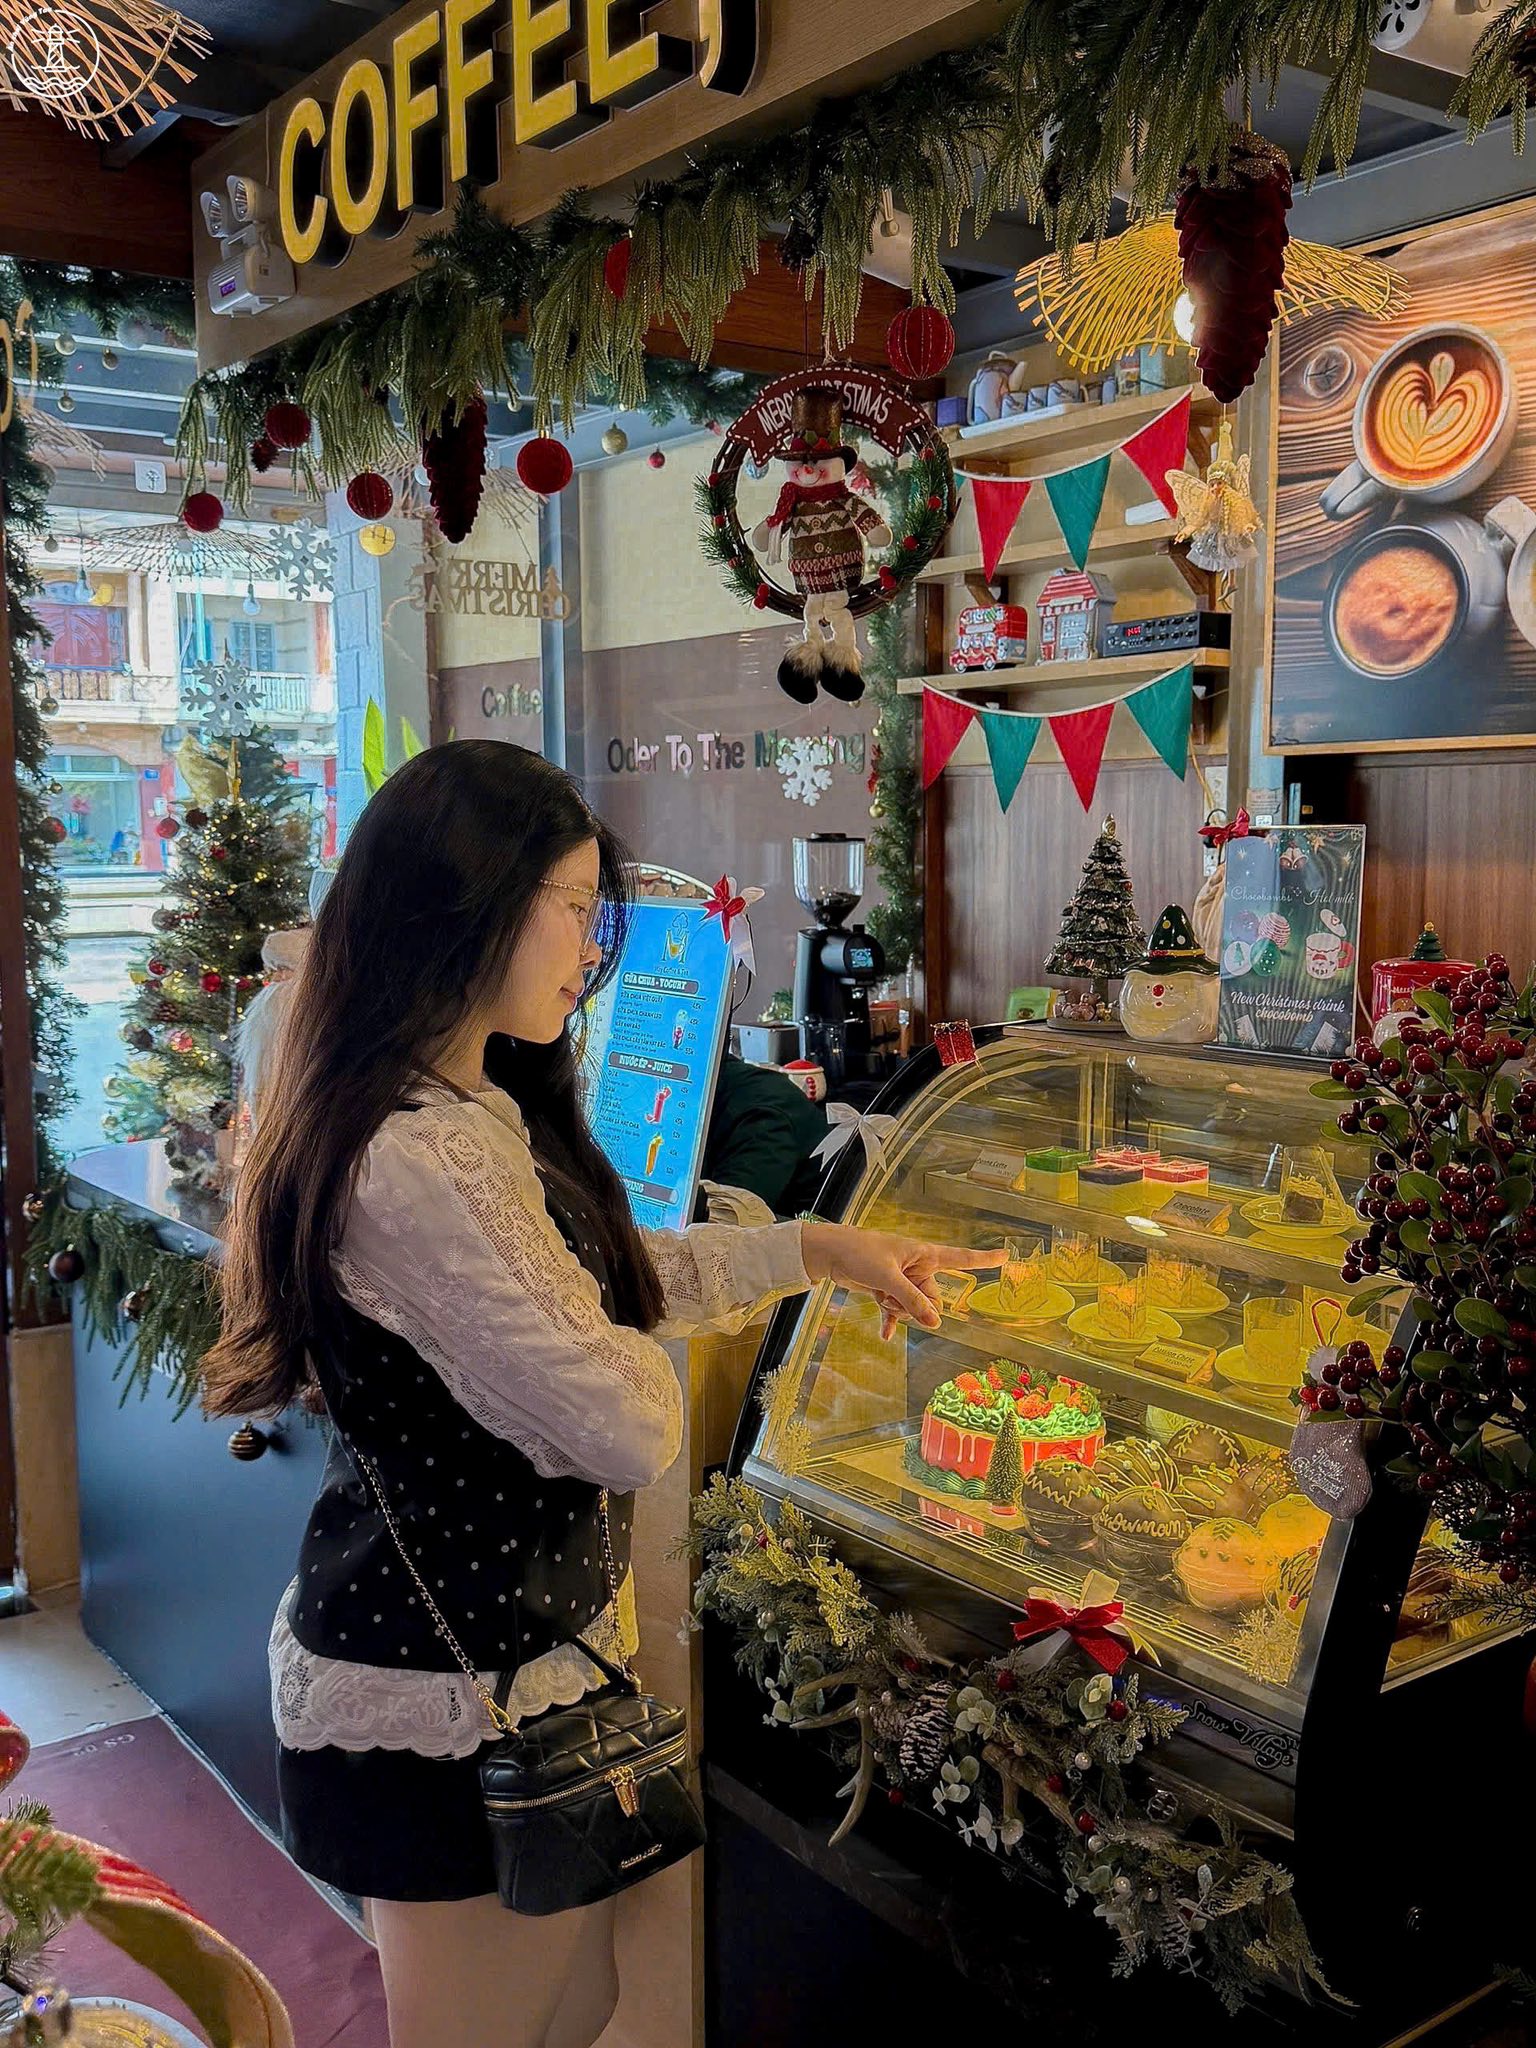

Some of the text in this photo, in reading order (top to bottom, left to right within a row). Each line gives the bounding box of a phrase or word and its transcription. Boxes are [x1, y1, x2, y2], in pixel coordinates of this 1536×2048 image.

[665, 735, 694, 772] To
[696, 733, 746, 772] The
[1230, 991, 1346, 1013] New Christmas drink
[1255, 1006, 1314, 1023] chocobomb
[652, 1062, 673, 1074] JUICE
[1182, 1700, 1229, 1732] Snow
[1232, 1718, 1291, 1770] Village
